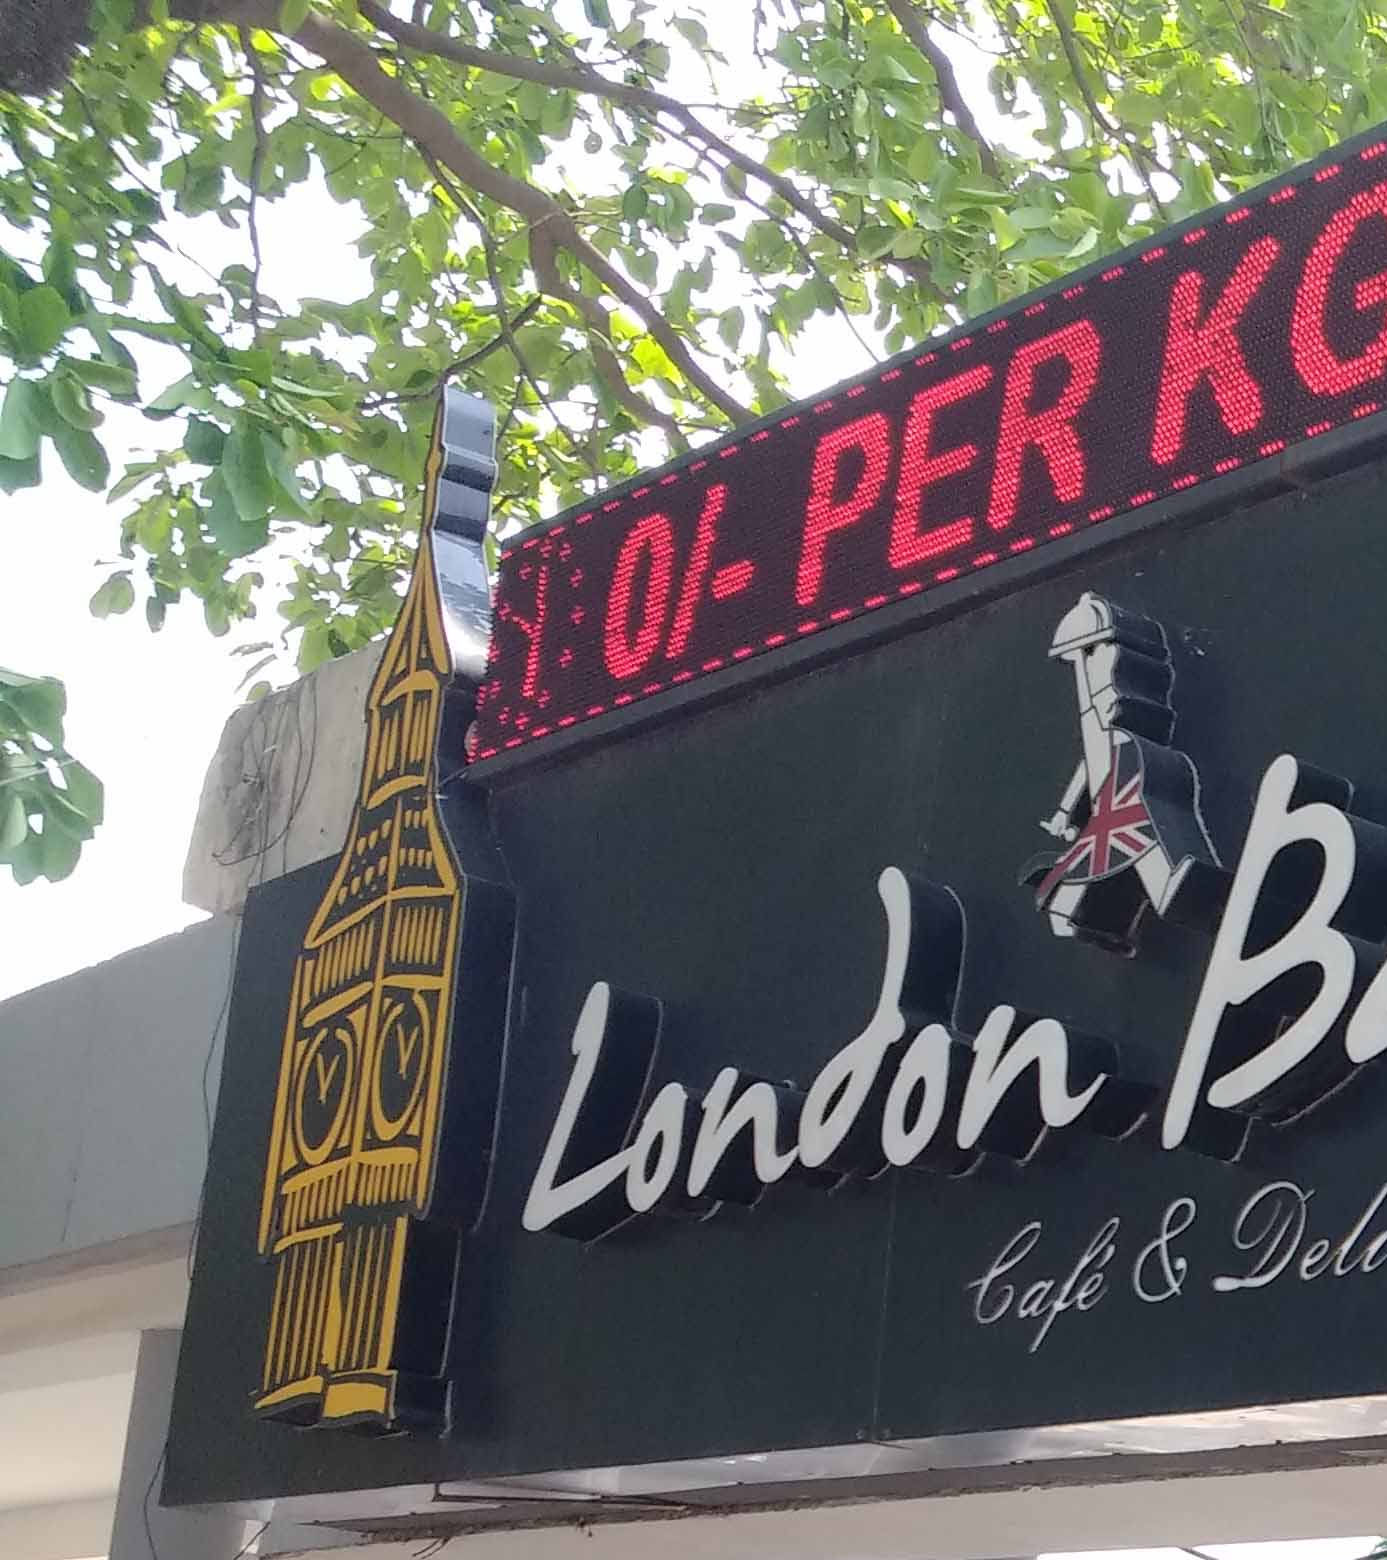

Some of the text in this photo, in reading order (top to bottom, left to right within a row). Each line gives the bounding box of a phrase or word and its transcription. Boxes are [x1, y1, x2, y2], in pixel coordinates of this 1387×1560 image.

[797, 318, 1101, 608] PER
[521, 866, 1107, 1232] London
[968, 1216, 1121, 1354] Café
[1133, 1197, 1197, 1303] &
